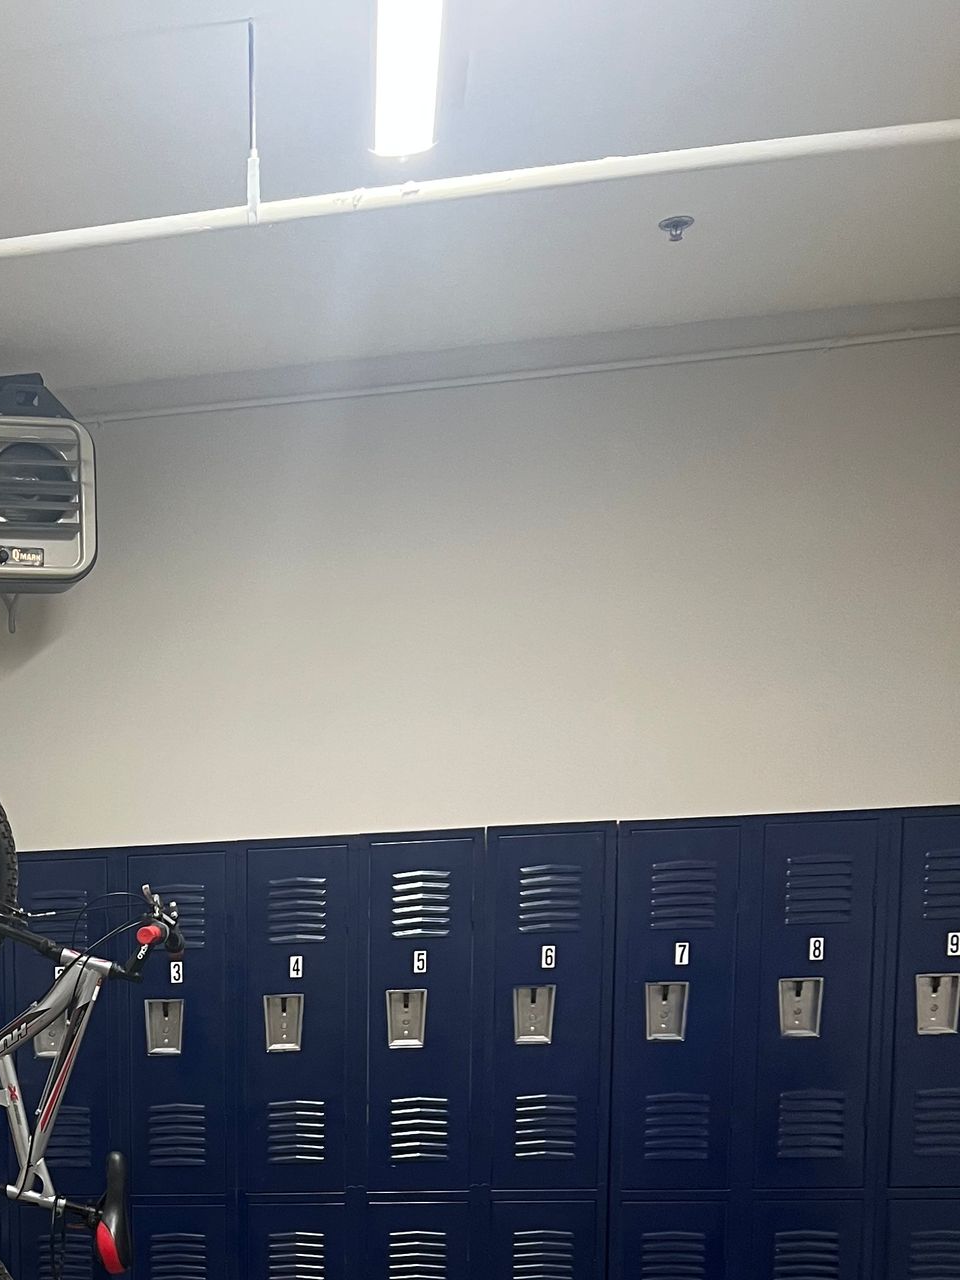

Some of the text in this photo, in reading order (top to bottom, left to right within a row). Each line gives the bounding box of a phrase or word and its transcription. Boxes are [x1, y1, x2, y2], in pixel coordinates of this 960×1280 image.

[678, 944, 687, 963] 7
[812, 939, 822, 959] 8
[949, 934, 960, 954] 9
[292, 957, 301, 976] 4
[416, 952, 425, 971] 5
[545, 947, 554, 967] 6
[172, 963, 181, 982] 3
